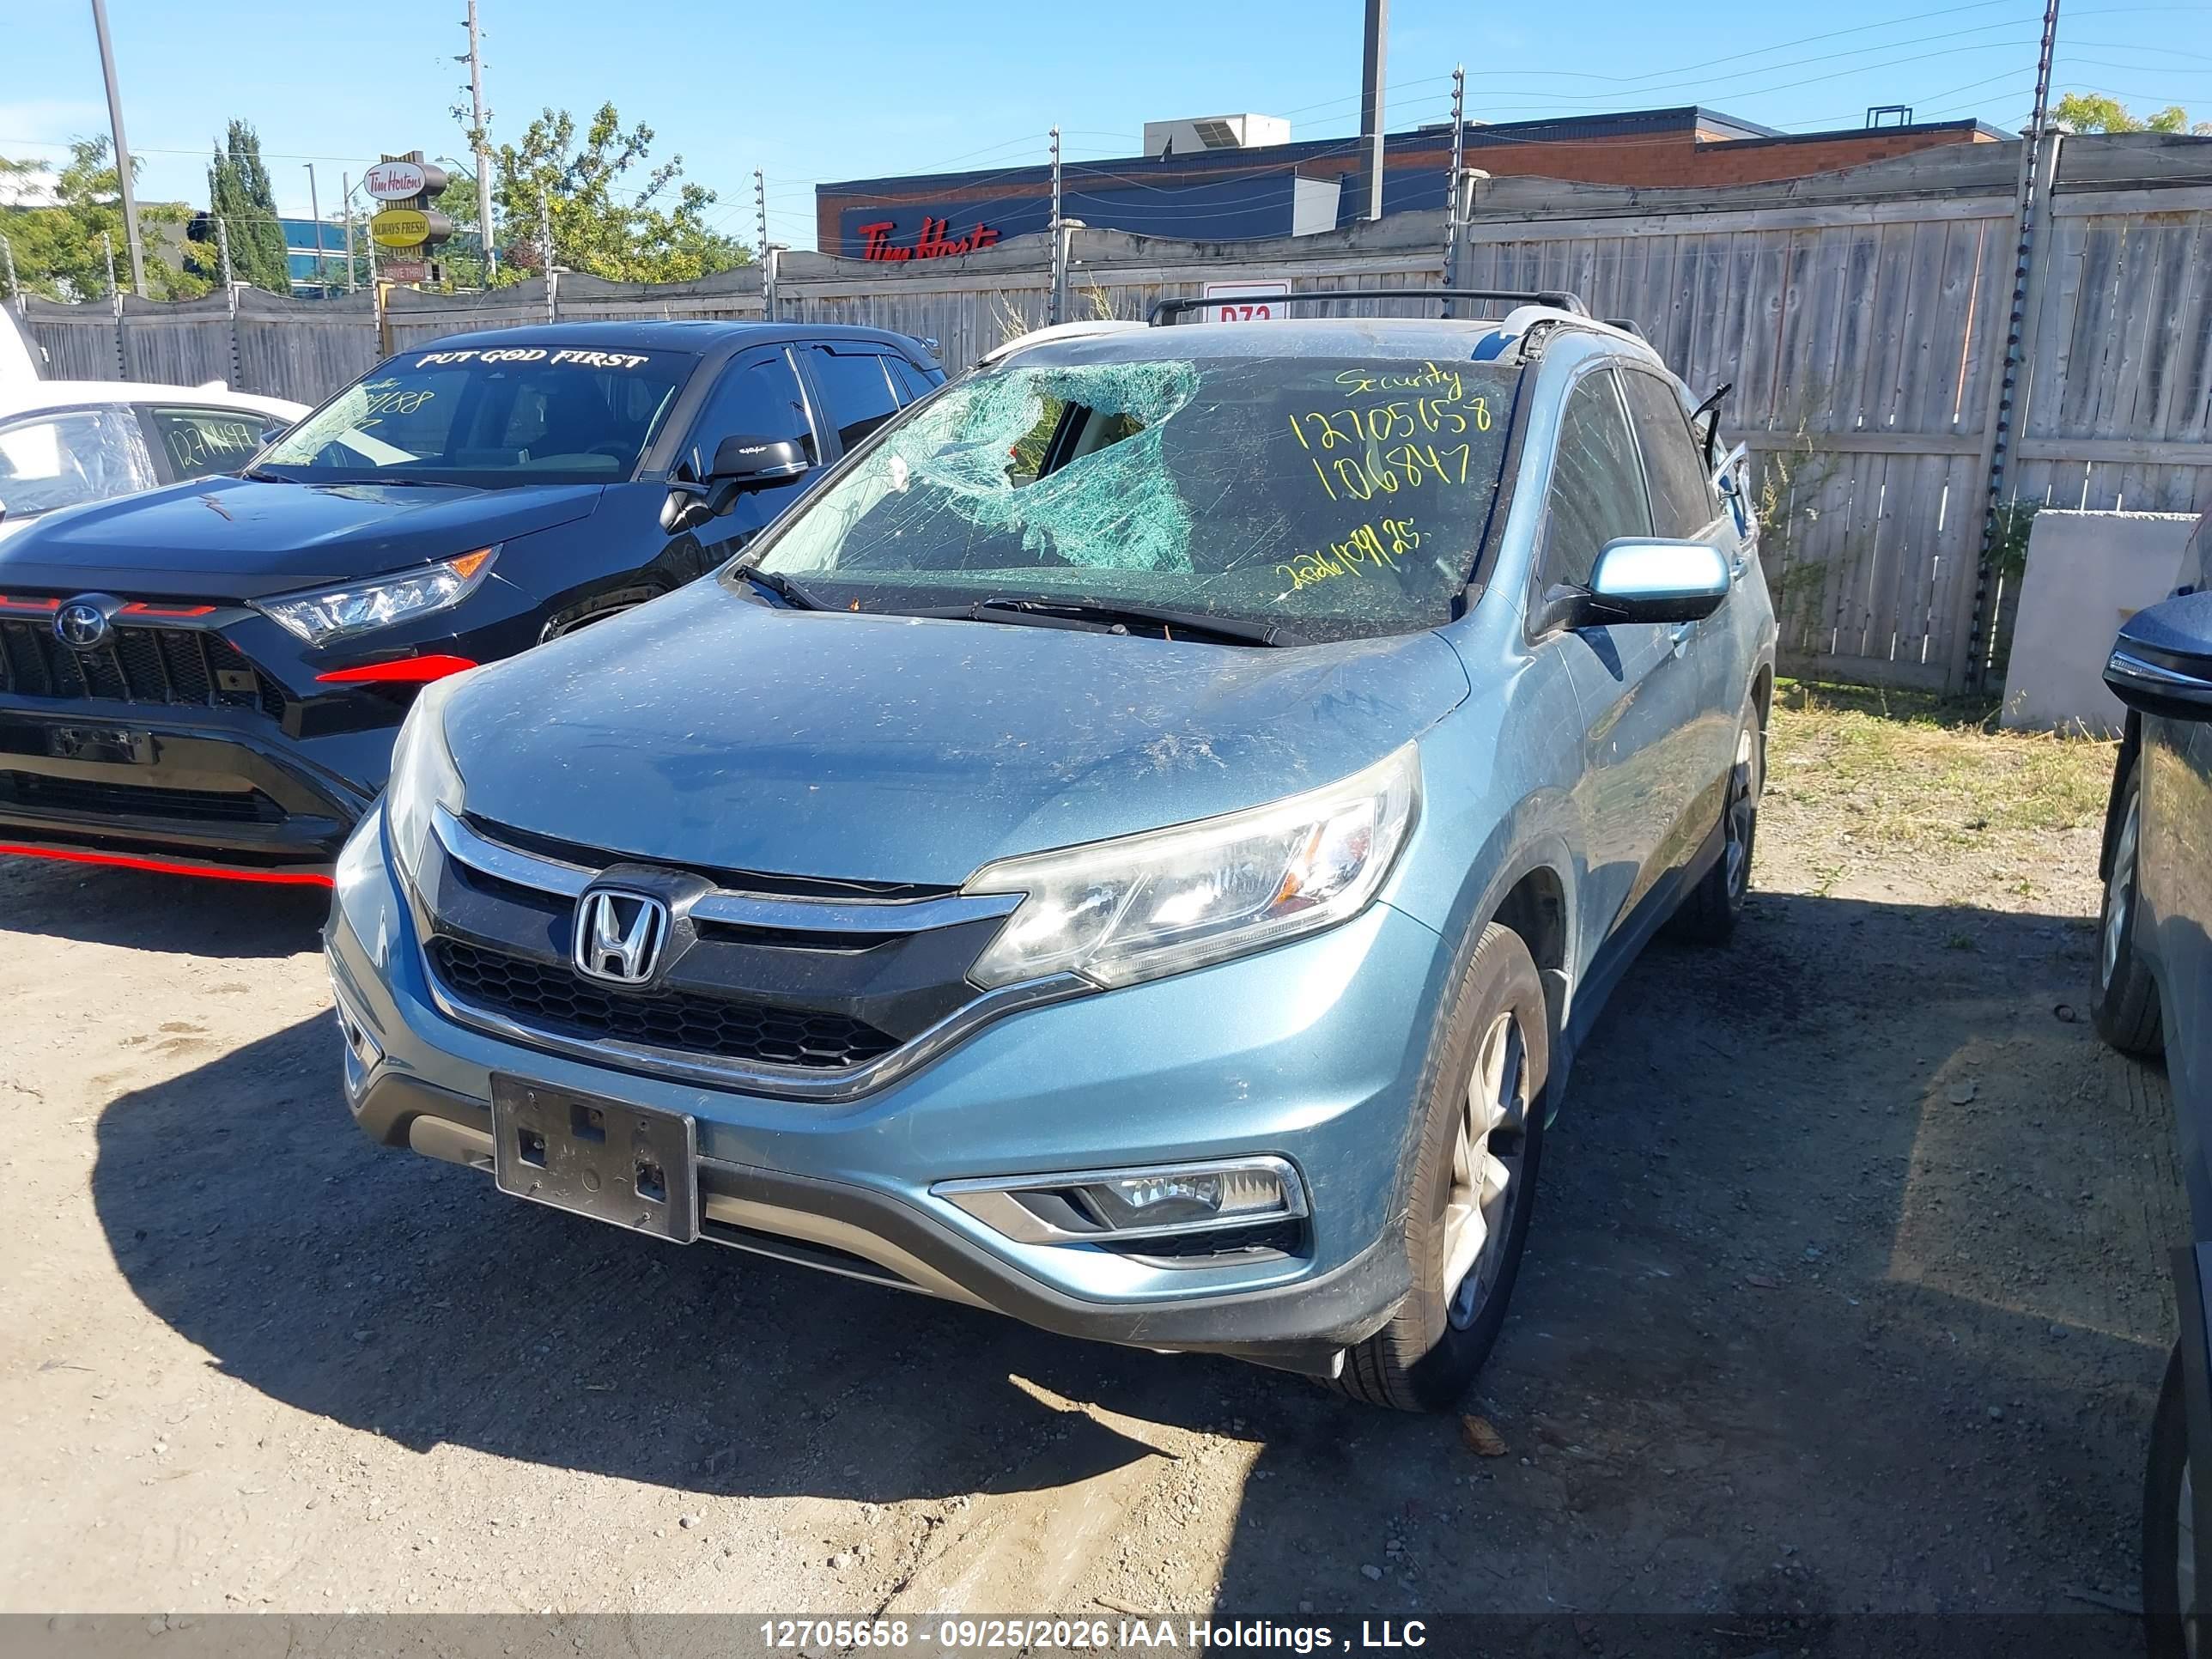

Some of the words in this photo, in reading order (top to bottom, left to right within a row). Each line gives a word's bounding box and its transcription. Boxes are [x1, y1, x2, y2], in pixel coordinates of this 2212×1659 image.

[368, 172, 386, 193] Tim
[386, 170, 422, 191] Hortons
[373, 222, 400, 235] ALWAYS
[401, 221, 426, 234] FRESH
[859, 222, 914, 261] Tim
[416, 350, 481, 368] PUT
[481, 349, 547, 362] GOD
[550, 349, 649, 368] FIRST
[1334, 362, 1462, 401] Security
[1289, 398, 1491, 450] 12705658
[1312, 443, 1470, 501] 106847
